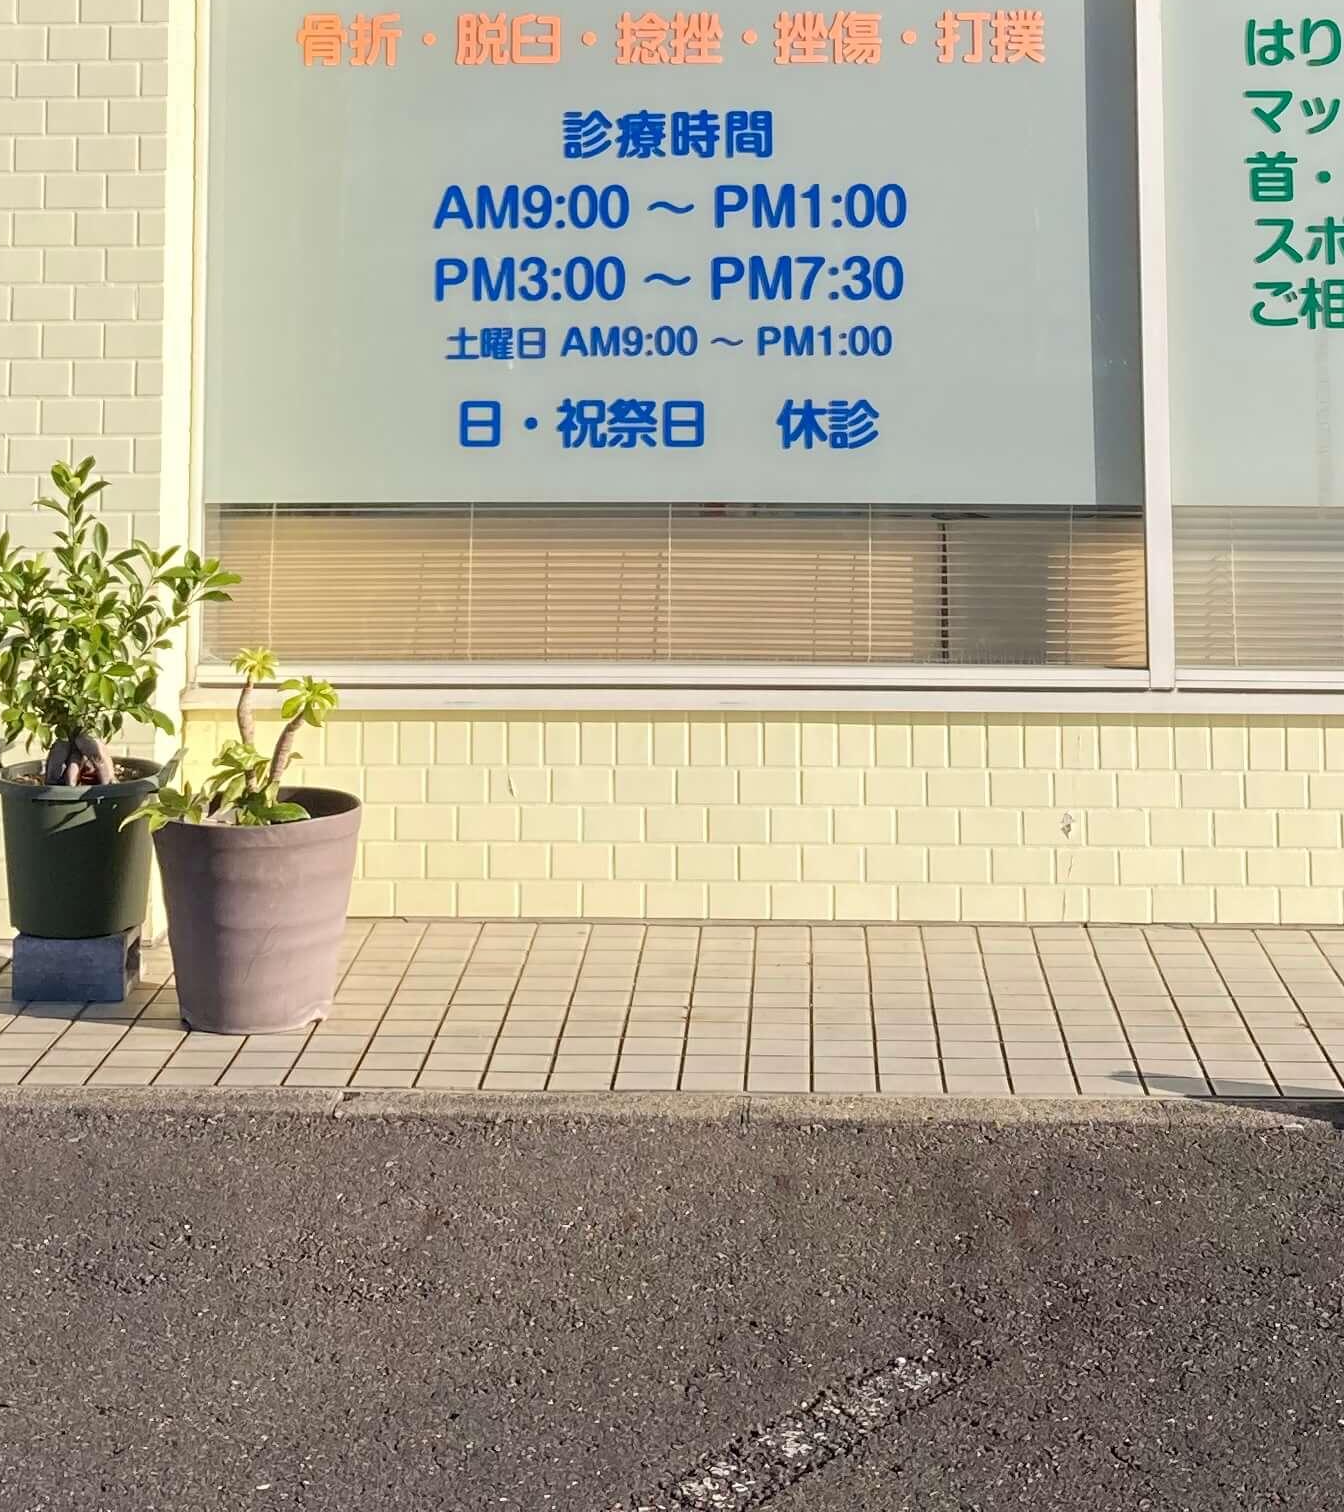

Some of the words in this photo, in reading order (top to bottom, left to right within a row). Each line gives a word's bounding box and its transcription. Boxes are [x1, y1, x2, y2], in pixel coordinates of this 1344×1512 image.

[562, 109, 775, 161] 診療時間
[432, 183, 632, 230] AM9:00
[713, 183, 909, 230] PM1:00
[433, 254, 627, 303] PM3:00
[709, 254, 906, 303] PM7:30
[444, 326, 548, 363] 土曜日
[559, 325, 699, 358] AM9:00
[756, 324, 894, 358] PM1:00
[458, 397, 706, 450] 日・祝祭日
[775, 397, 882, 451] 休診
